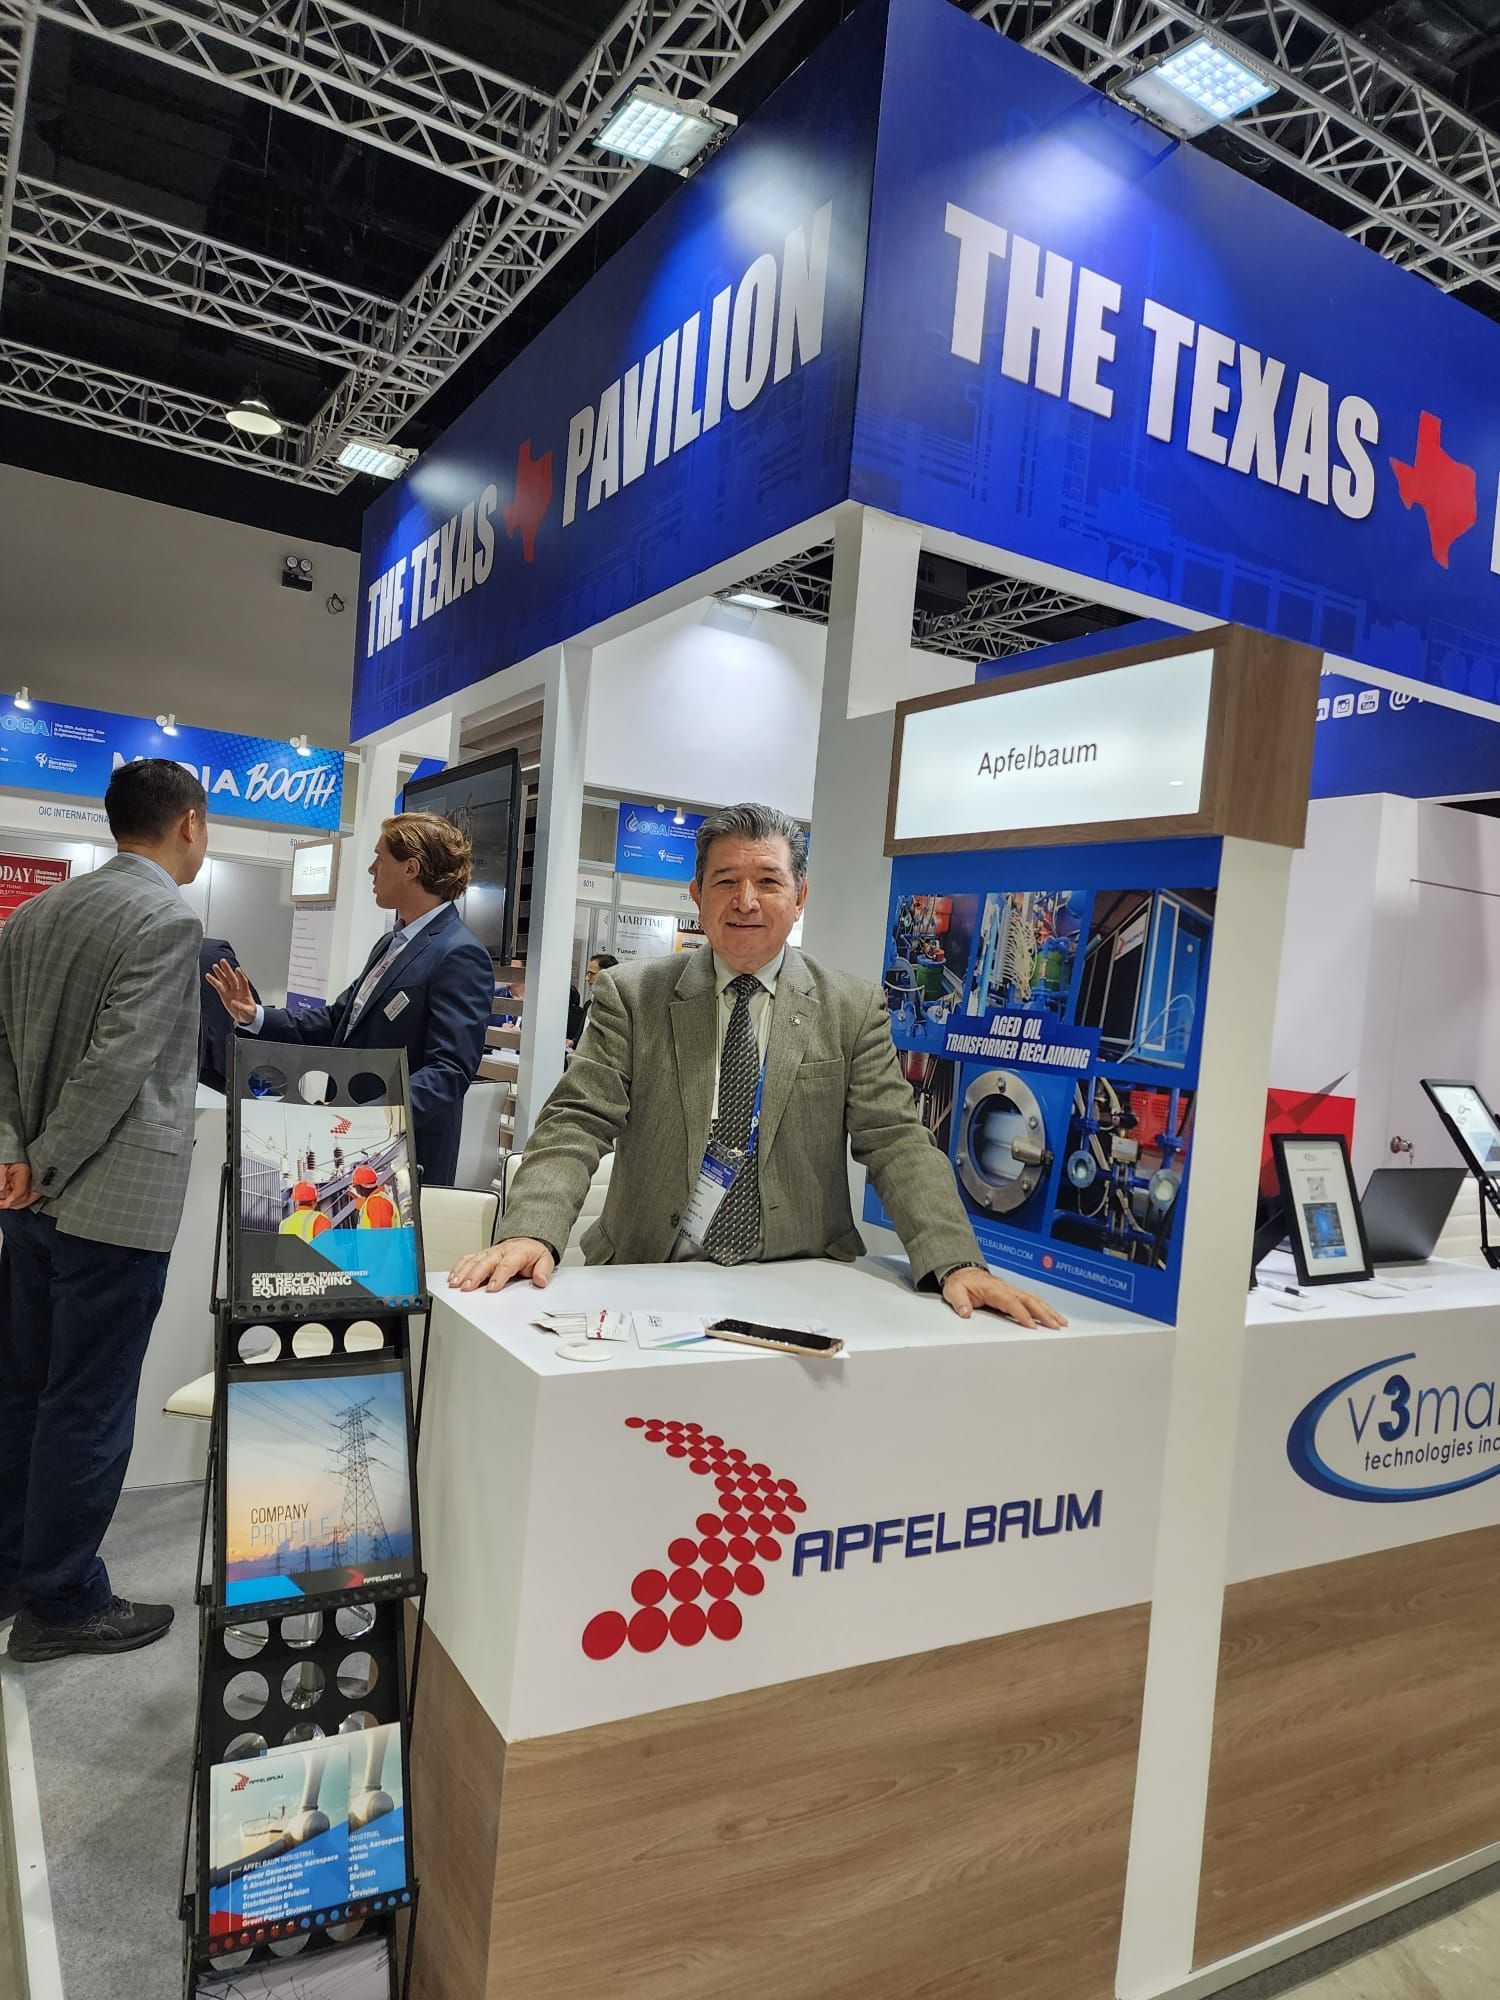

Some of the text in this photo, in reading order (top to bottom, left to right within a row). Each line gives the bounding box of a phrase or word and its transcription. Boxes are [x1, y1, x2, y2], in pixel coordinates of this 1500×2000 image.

[944, 202, 1379, 519] THE TEXAS
[367, 200, 833, 658] THE TEXAS PAVILION
[977, 740, 1098, 780] Apfelbaum
[245, 762, 336, 810] BOOTH
[39, 806, 110, 824] OIC INTERNATIONA
[618, 914, 665, 929] MARITIME
[989, 1015, 1042, 1040] AGED OIL
[945, 1033, 1091, 1069] TRANSFORMER RECLAIMING
[318, 1270, 368, 1278] TRANSFORMER
[976, 1235, 1127, 1291] PFELBAUMIND.COM APFELBAUMIND.COM
[251, 1276, 352, 1287] OIL RECLAIMING
[252, 1285, 328, 1298] EQUIPMENT
[1347, 1374, 1500, 1445] v3ma
[1364, 1439, 1473, 1472] technologies
[251, 1502, 309, 1524] COMPANY
[251, 1516, 331, 1546] PROFILE
[792, 1489, 1103, 1577] APFELBAUM
[348, 1853, 369, 1862] vision
[249, 1879, 276, 1889] Aircraft
[277, 1871, 304, 1882] Division
[349, 1869, 376, 1881] Division
[243, 1885, 288, 1901] Transmission
[243, 1887, 310, 1910] Distribution Division
[285, 1904, 312, 1916] Division
